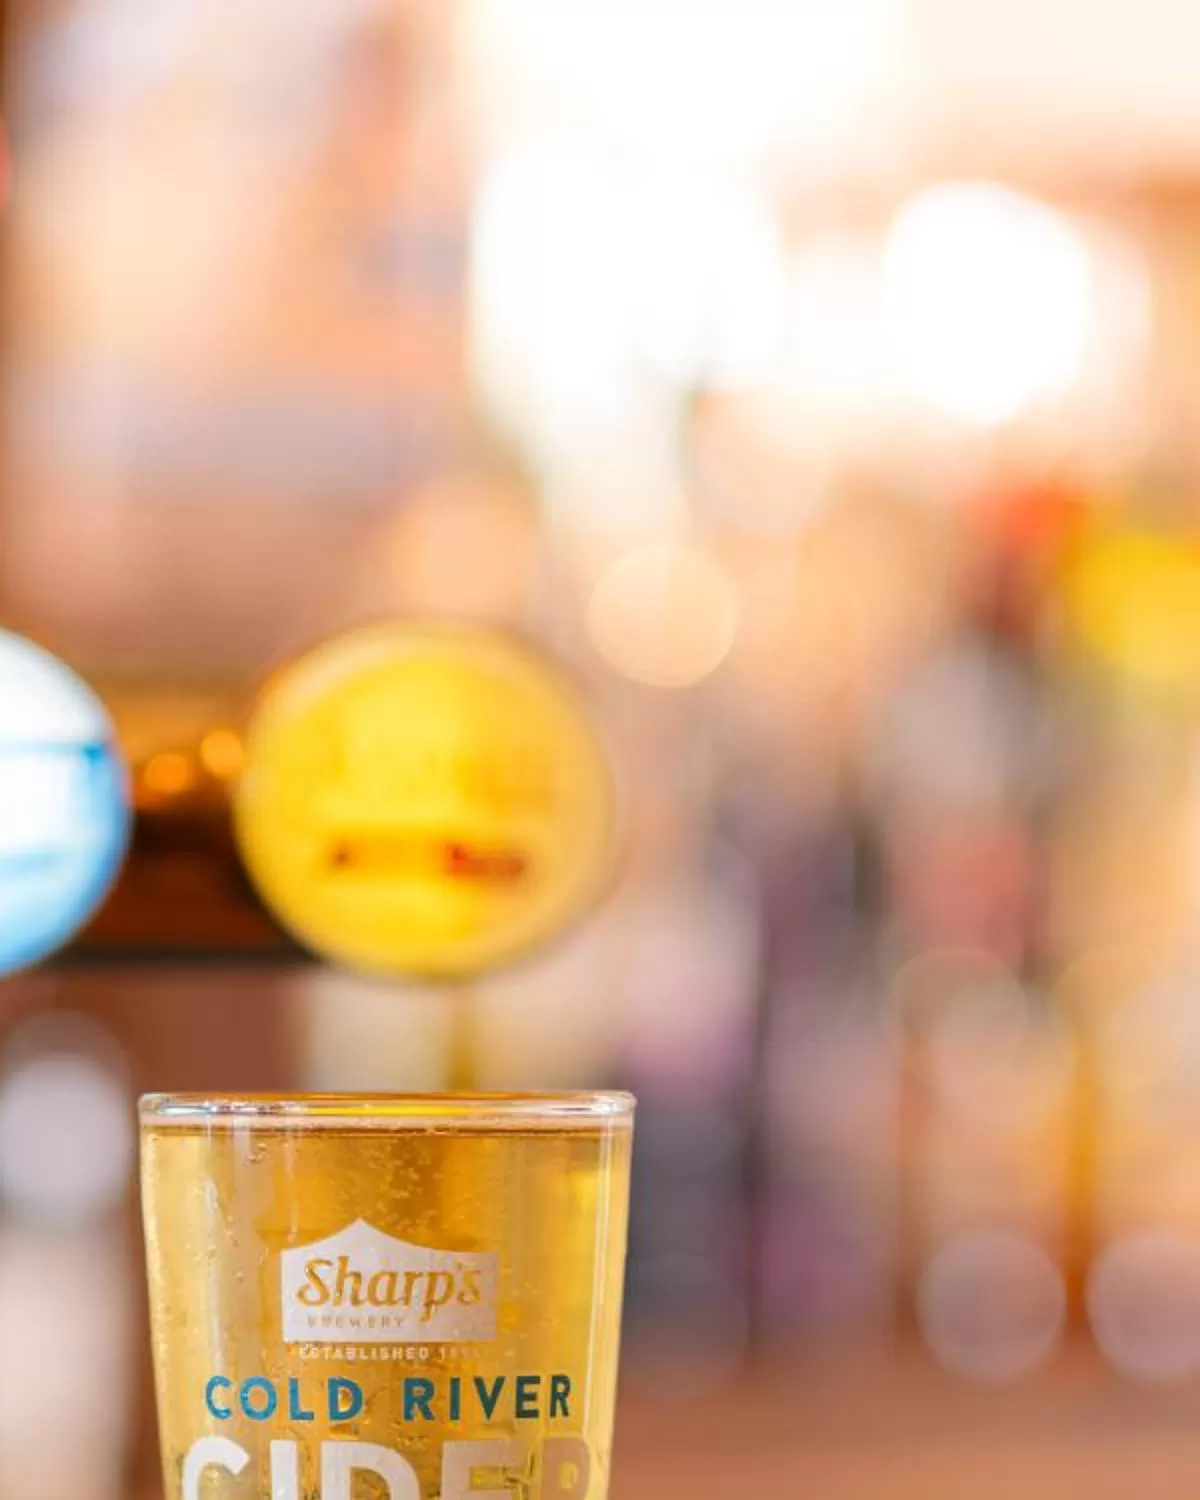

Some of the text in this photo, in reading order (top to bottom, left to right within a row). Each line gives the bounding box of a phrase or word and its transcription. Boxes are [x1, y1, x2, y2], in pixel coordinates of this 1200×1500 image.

[297, 1255, 482, 1322] Sharp's
[299, 1344, 430, 1361] ESTABLISHED
[204, 1375, 572, 1421] COLD RIVER
